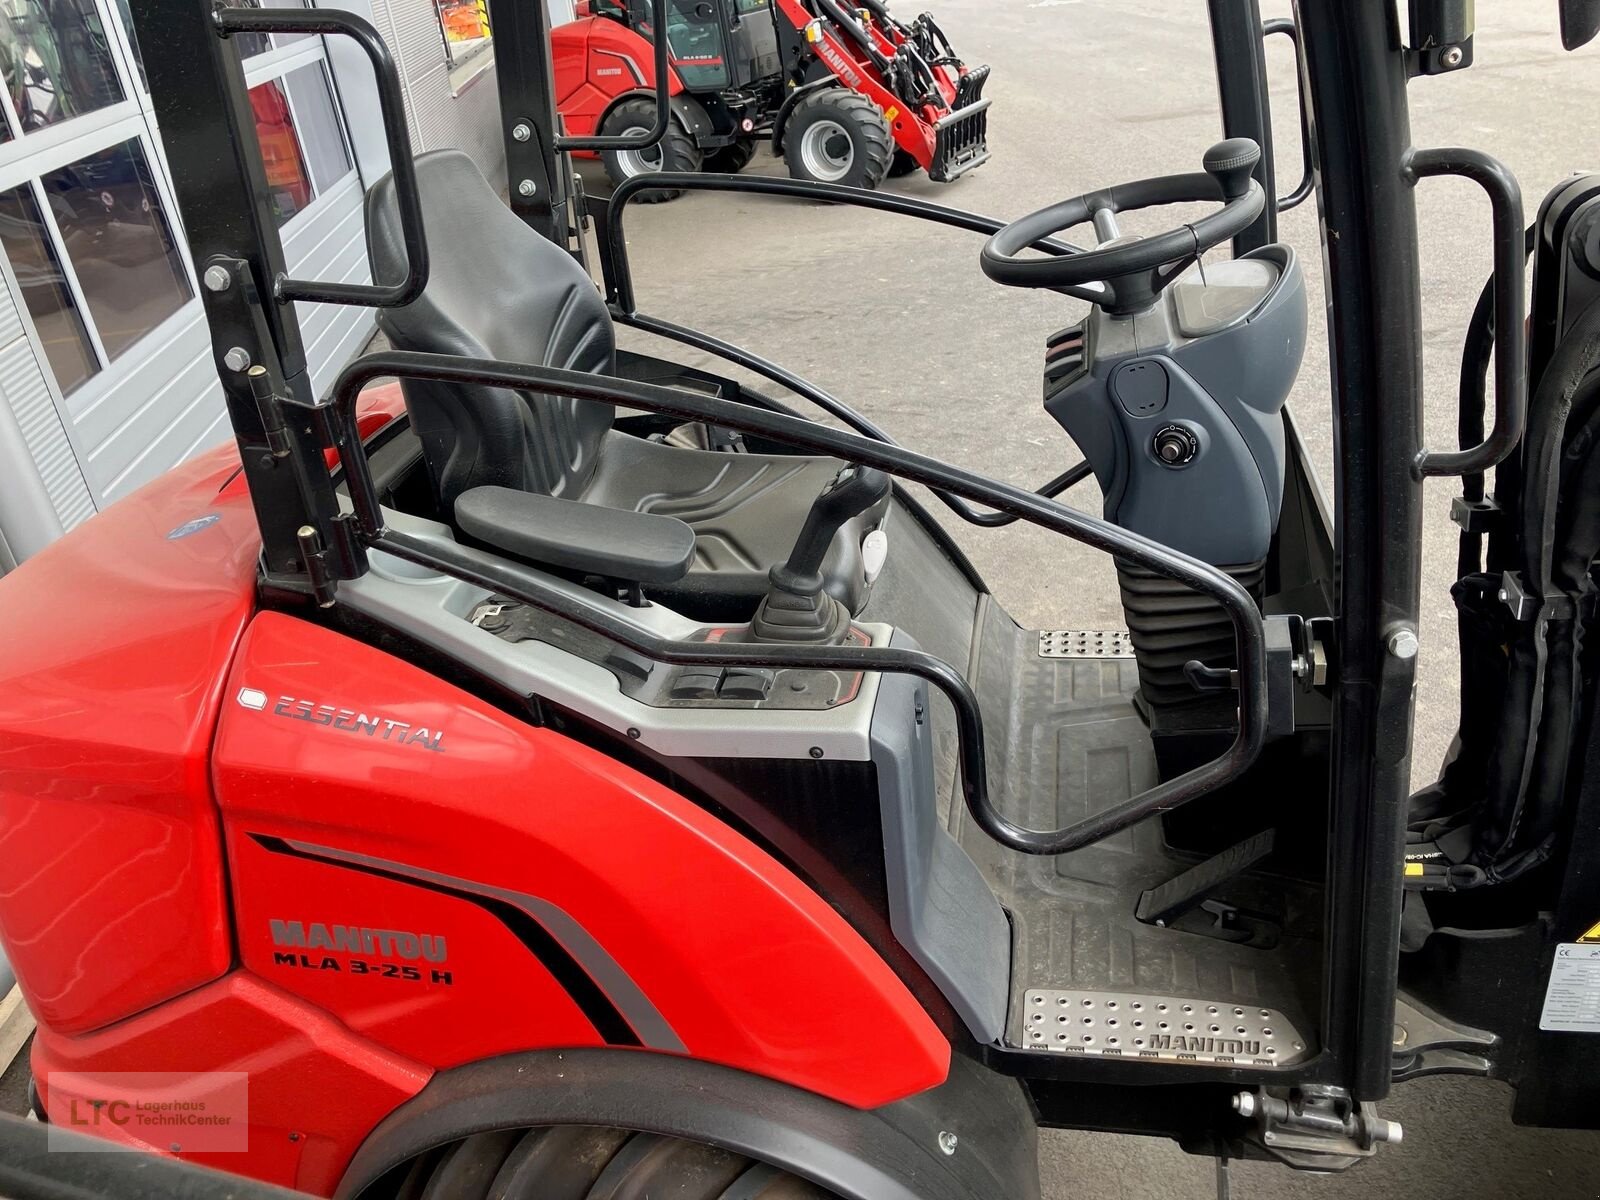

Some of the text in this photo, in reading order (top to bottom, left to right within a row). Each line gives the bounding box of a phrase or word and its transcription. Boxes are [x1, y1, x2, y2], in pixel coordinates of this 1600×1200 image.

[816, 41, 862, 87] MANITOU
[273, 695, 446, 752] ESSENTIAL
[269, 918, 447, 963] MANITOU
[273, 952, 453, 985] MLA 3-25 H
[1150, 1034, 1260, 1055] MANITOU
